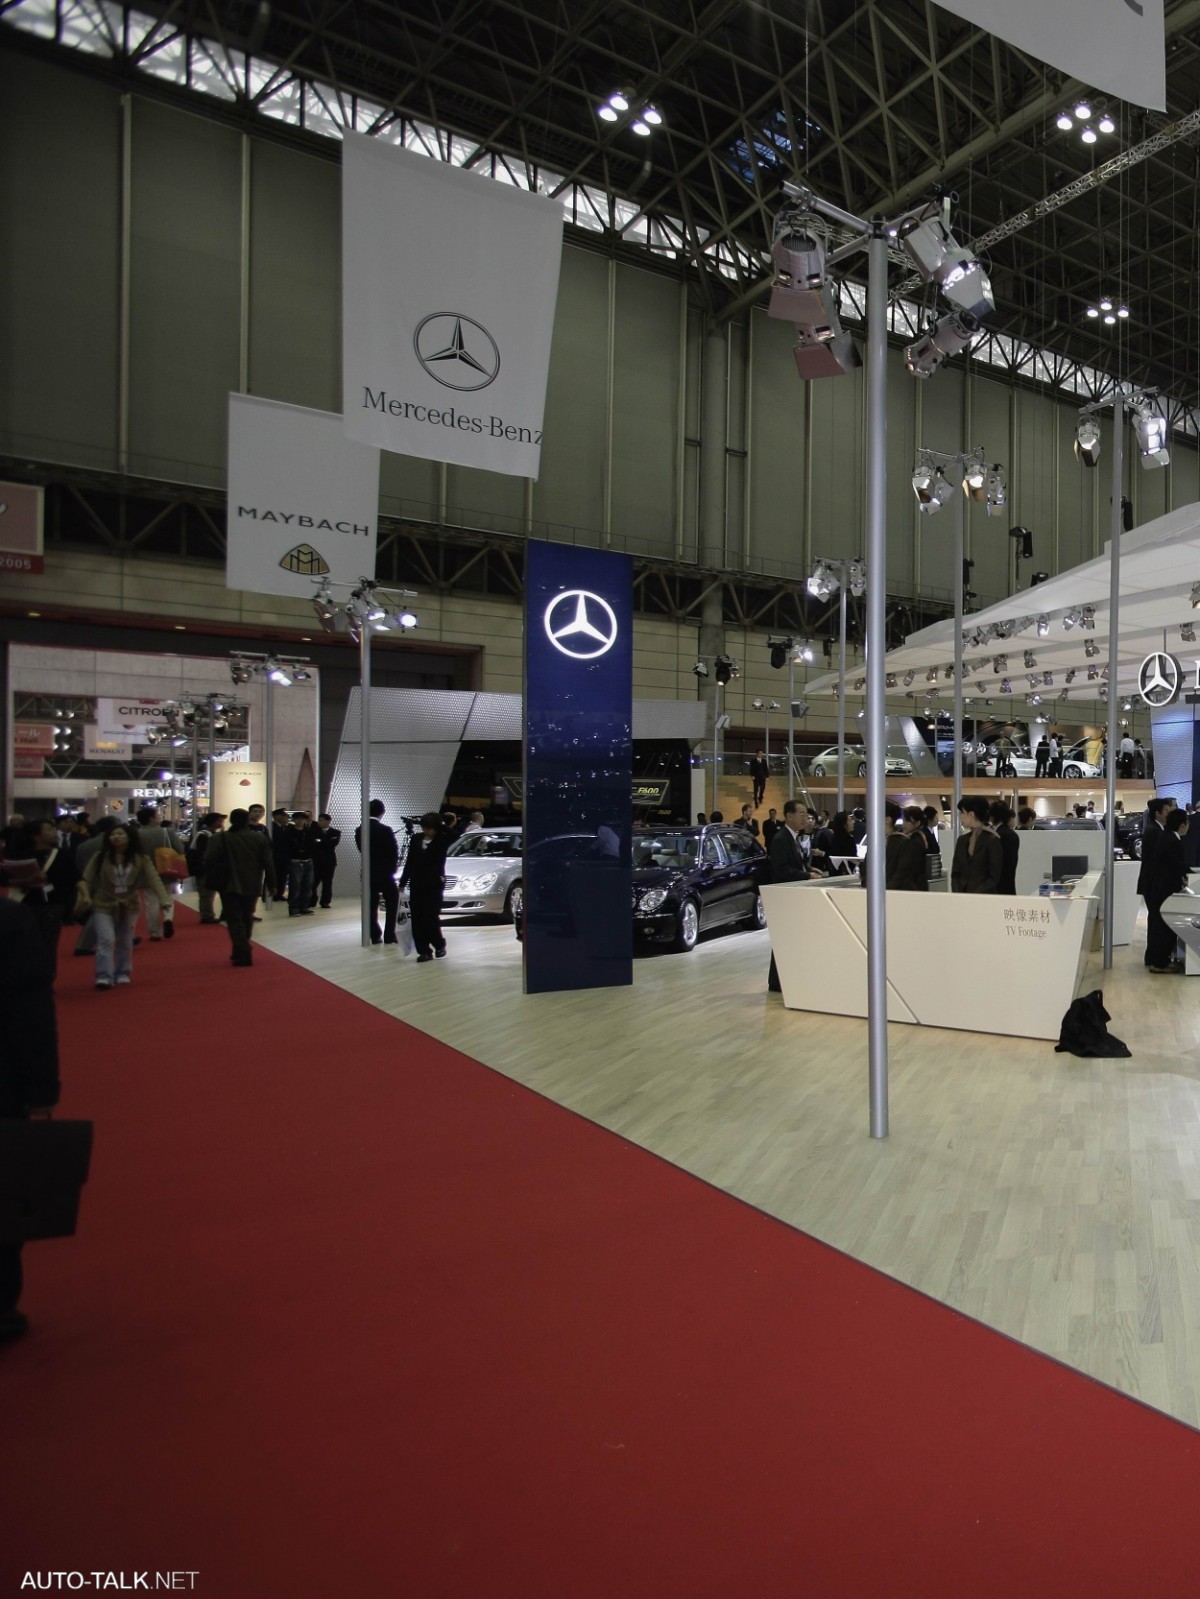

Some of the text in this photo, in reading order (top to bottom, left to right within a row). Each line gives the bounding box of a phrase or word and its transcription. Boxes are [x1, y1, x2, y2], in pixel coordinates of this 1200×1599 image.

[362, 386, 543, 446] Mercedes-Benz
[238, 505, 369, 537] MAYBACH
[1003, 908, 1051, 923] 映像素材
[1005, 925, 1047, 940] TV Footage
